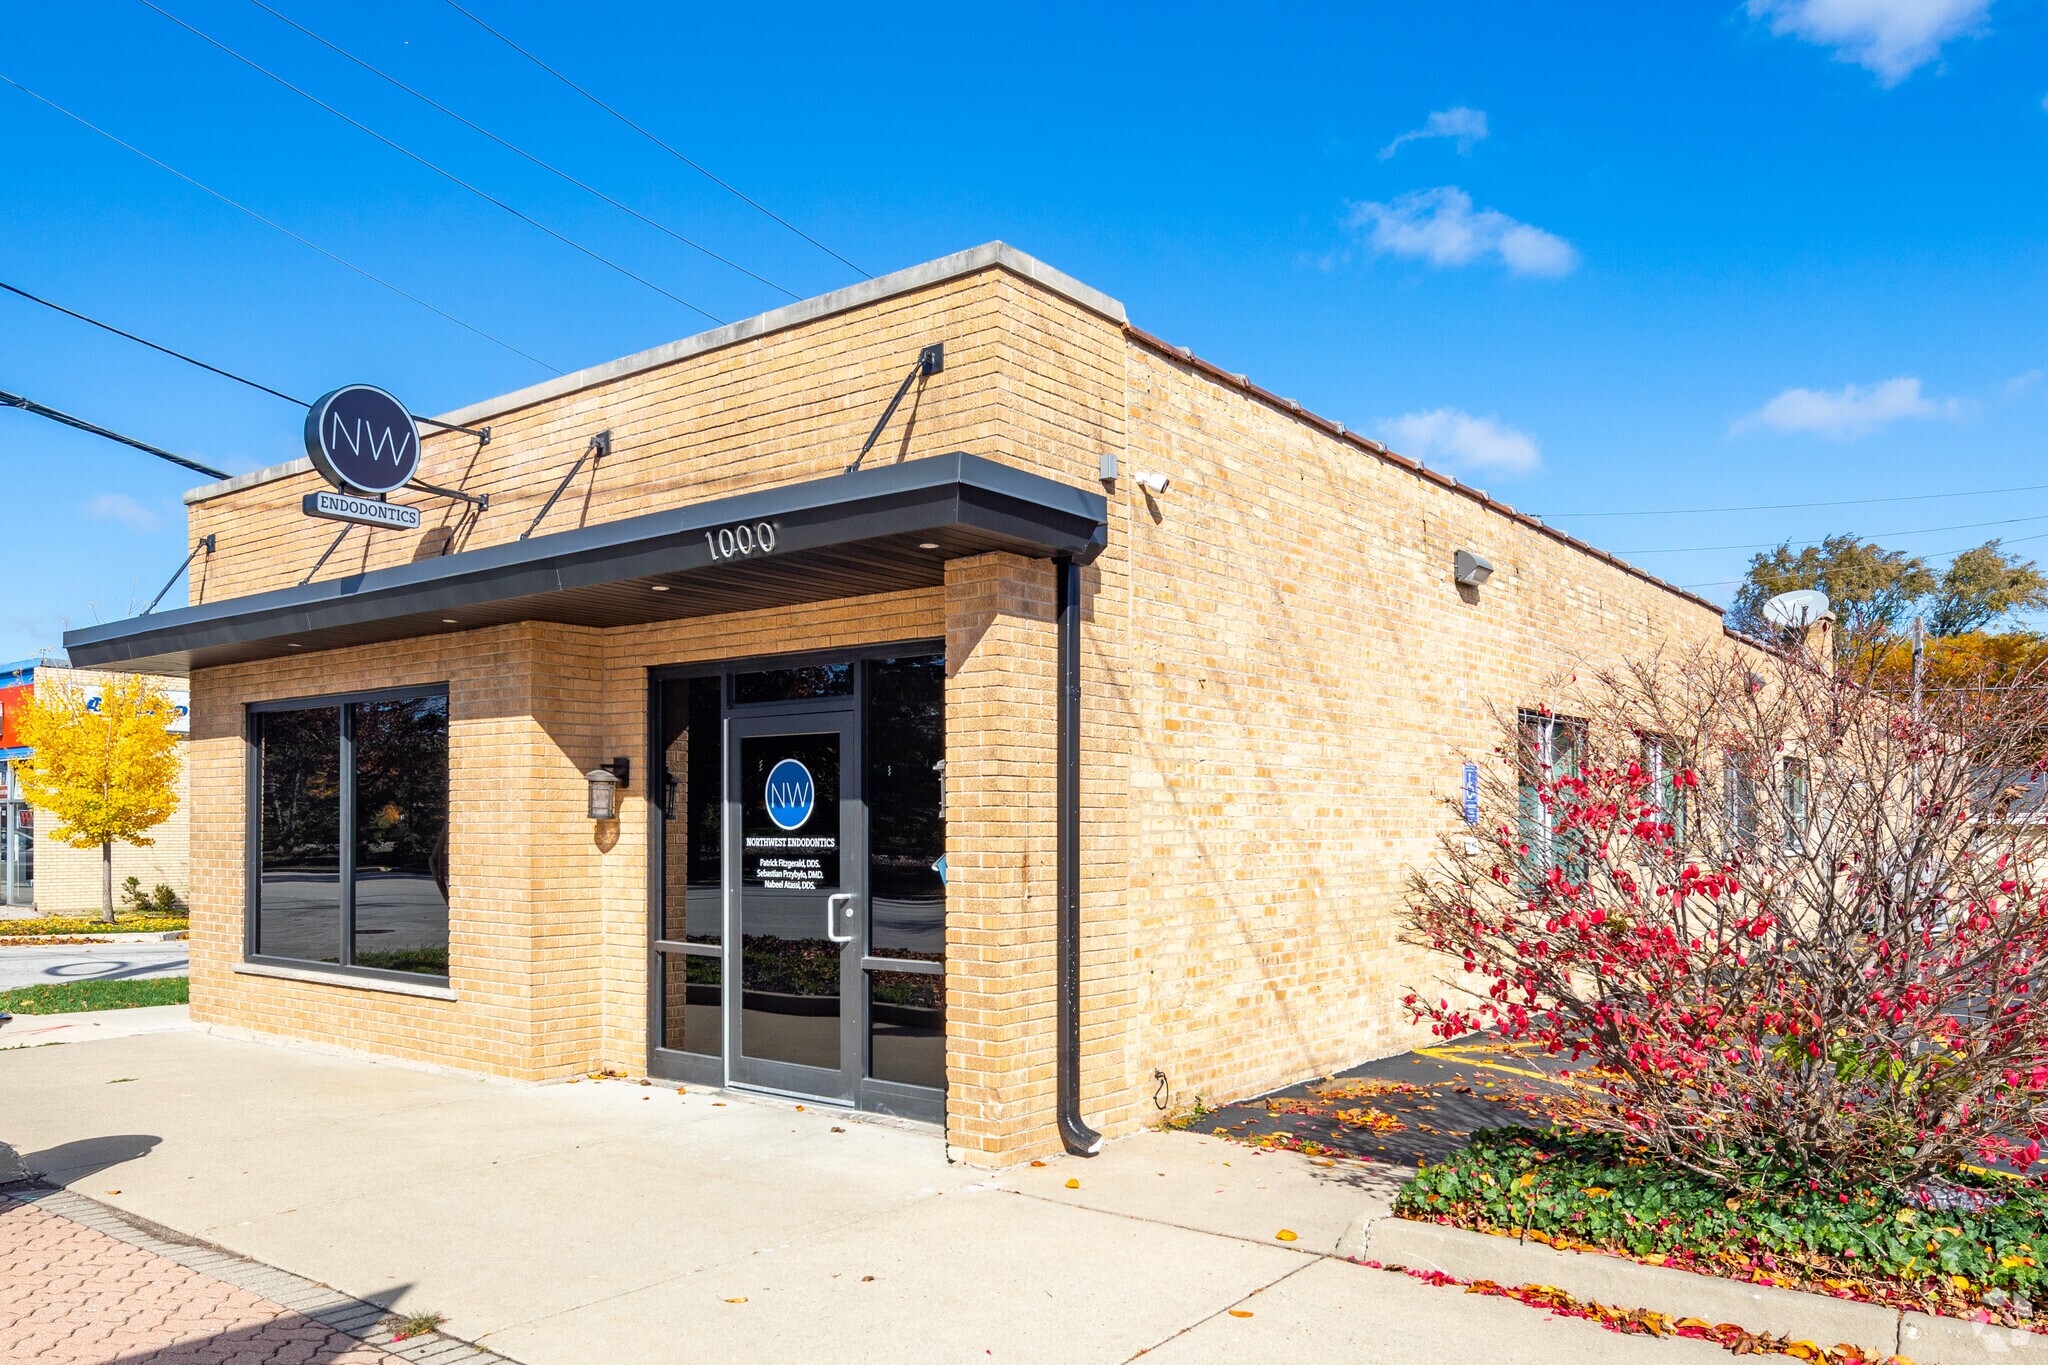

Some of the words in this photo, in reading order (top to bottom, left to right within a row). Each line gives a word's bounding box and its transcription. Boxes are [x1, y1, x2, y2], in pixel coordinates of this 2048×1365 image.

[331, 411, 411, 466] NW
[320, 495, 416, 523] ENDODONTICS
[705, 522, 775, 560] 1000
[771, 782, 809, 808] NW
[746, 837, 787, 847] NORTHWEST
[788, 838, 835, 848] ENDODONTICS
